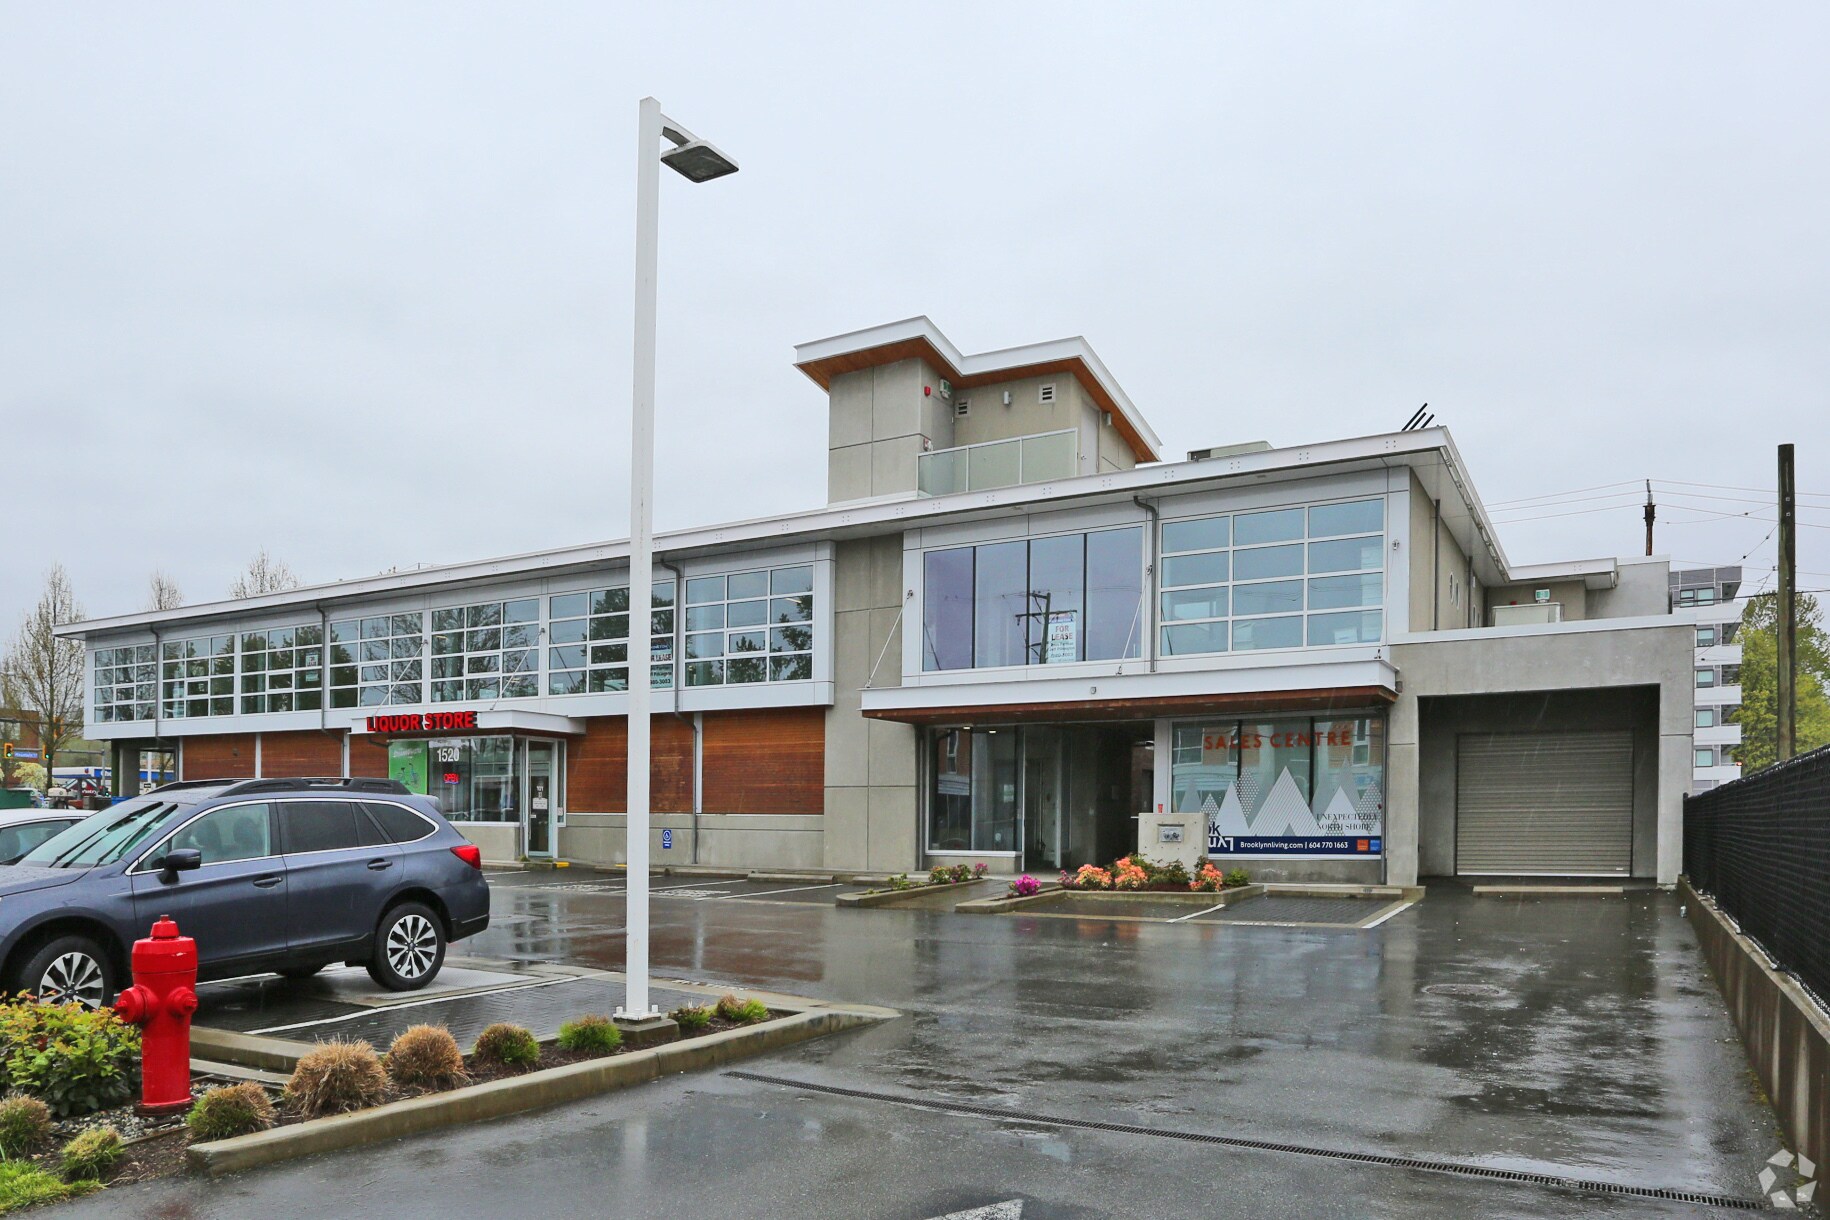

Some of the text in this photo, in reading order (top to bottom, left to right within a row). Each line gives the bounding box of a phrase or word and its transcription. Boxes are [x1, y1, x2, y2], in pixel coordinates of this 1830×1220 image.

[1051, 633, 1073, 641] LEASE
[366, 711, 475, 732] LIQUOR STORE
[1204, 731, 1352, 750] SALES CENTRE
[436, 747, 460, 762] 1520
[443, 773, 460, 783] OPEN
[1316, 813, 1377, 821] UNEXPECTEDLY
[1316, 823, 1370, 831] NORTH SHORE
[1309, 841, 1320, 849] 604
[1321, 841, 1333, 849] 770
[1334, 841, 1348, 849] 1663
